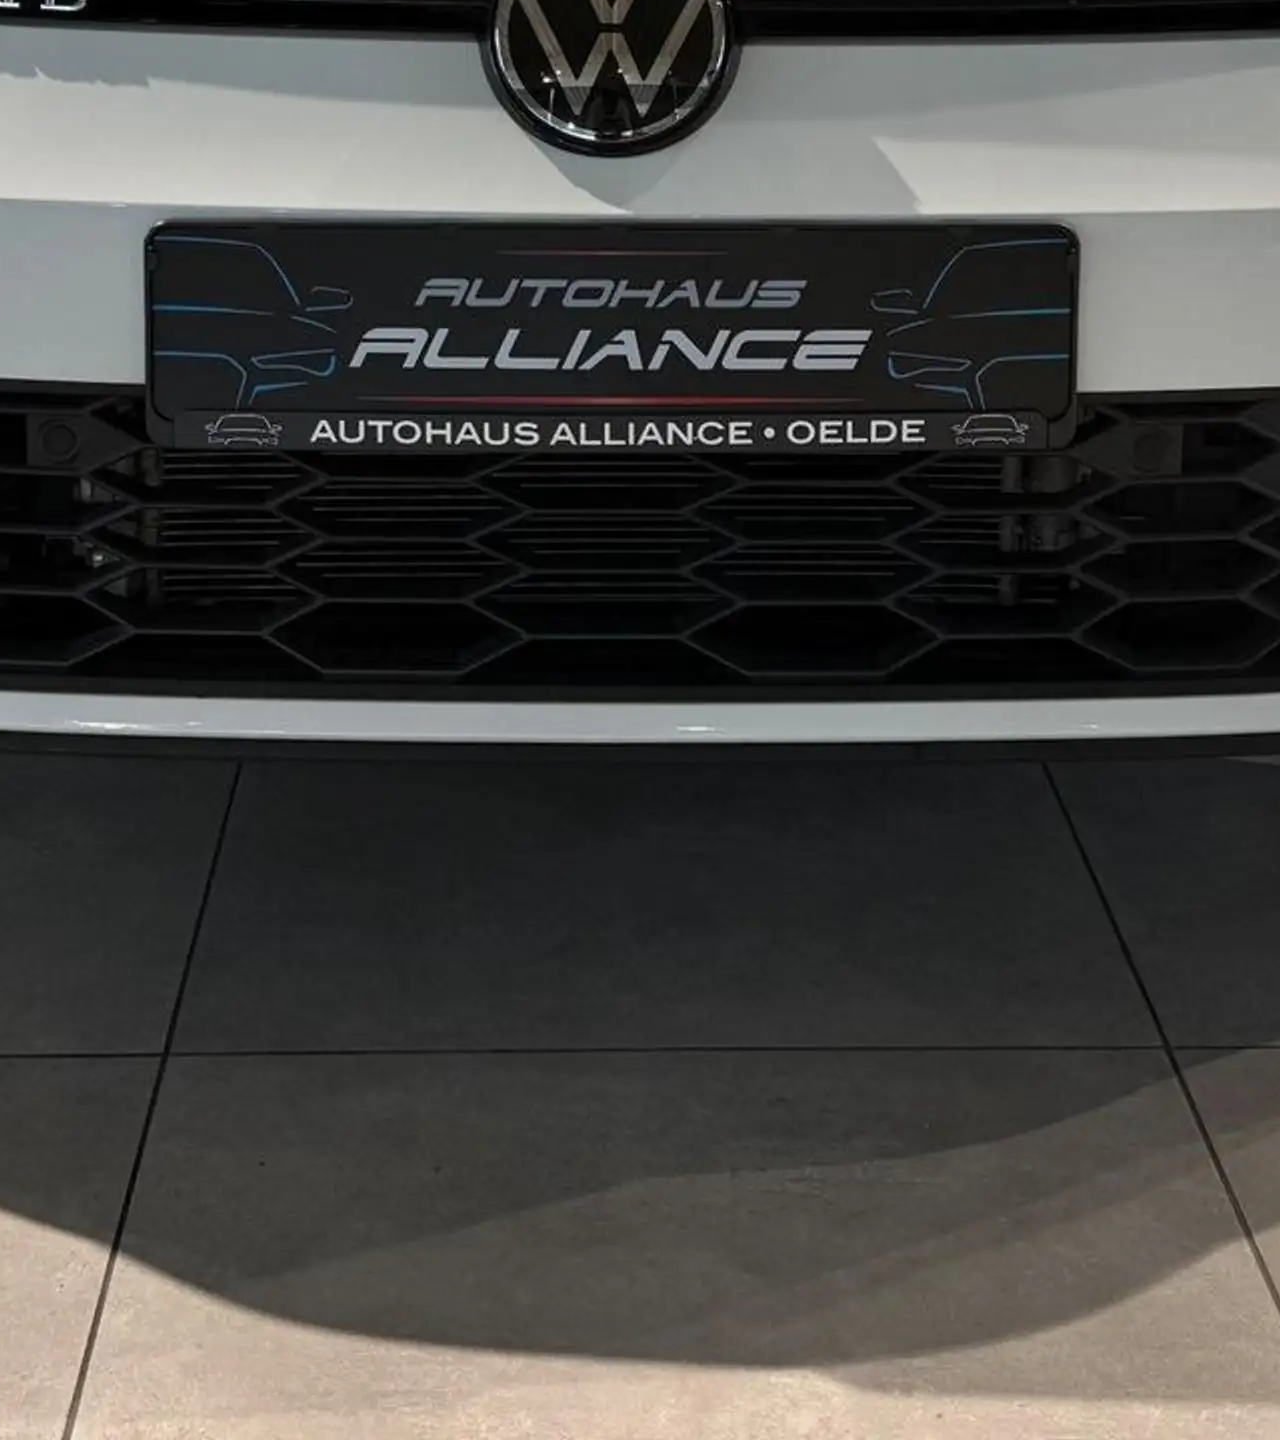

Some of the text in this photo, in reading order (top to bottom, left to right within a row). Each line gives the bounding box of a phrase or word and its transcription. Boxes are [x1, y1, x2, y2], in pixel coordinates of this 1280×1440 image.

[414, 277, 808, 309] AUTOHAUS
[349, 326, 874, 371] ALLIANCE
[309, 419, 926, 447] AUTOHAUS ALLIANCE OELDE
